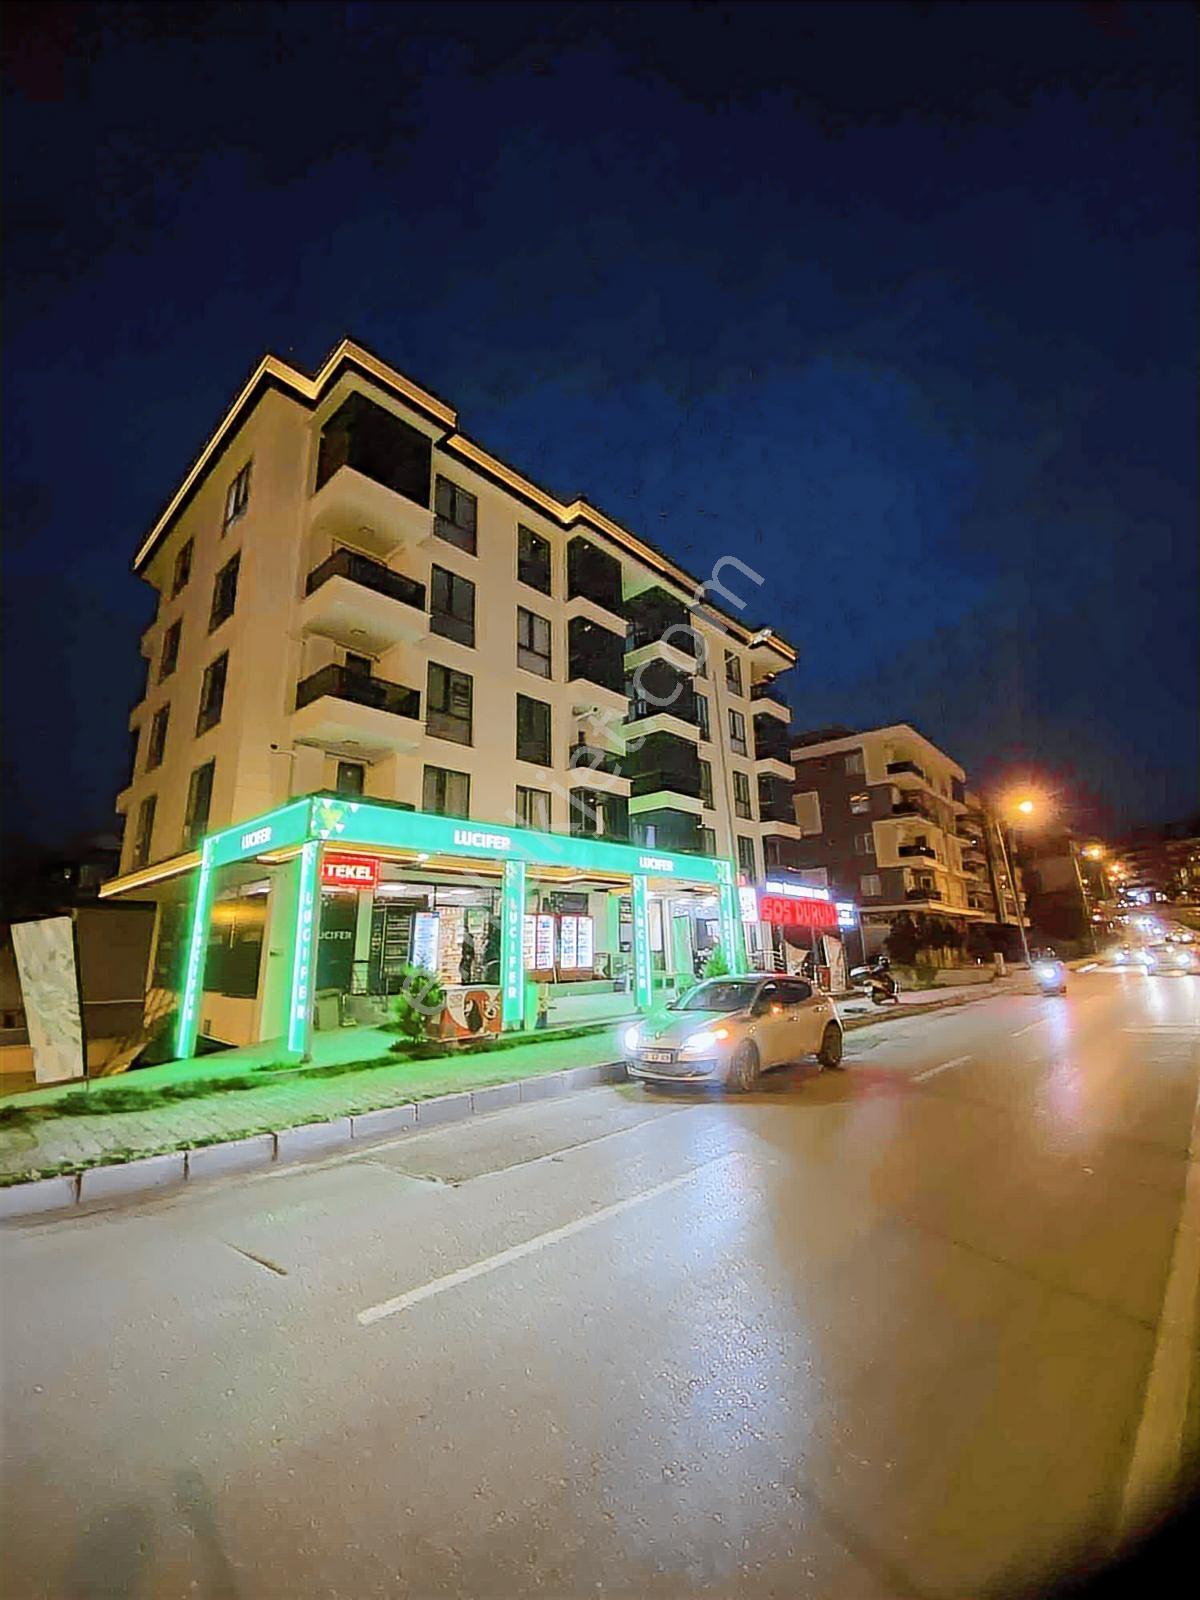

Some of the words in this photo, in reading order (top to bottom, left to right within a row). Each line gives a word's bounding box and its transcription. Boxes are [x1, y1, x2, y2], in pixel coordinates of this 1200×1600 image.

[453, 828, 511, 851] LUCIFER
[325, 863, 374, 880] TEKEL
[638, 855, 673, 871] LUCIFER
[318, 930, 353, 940] UCIFER
[508, 898, 518, 999] LUCIFER
